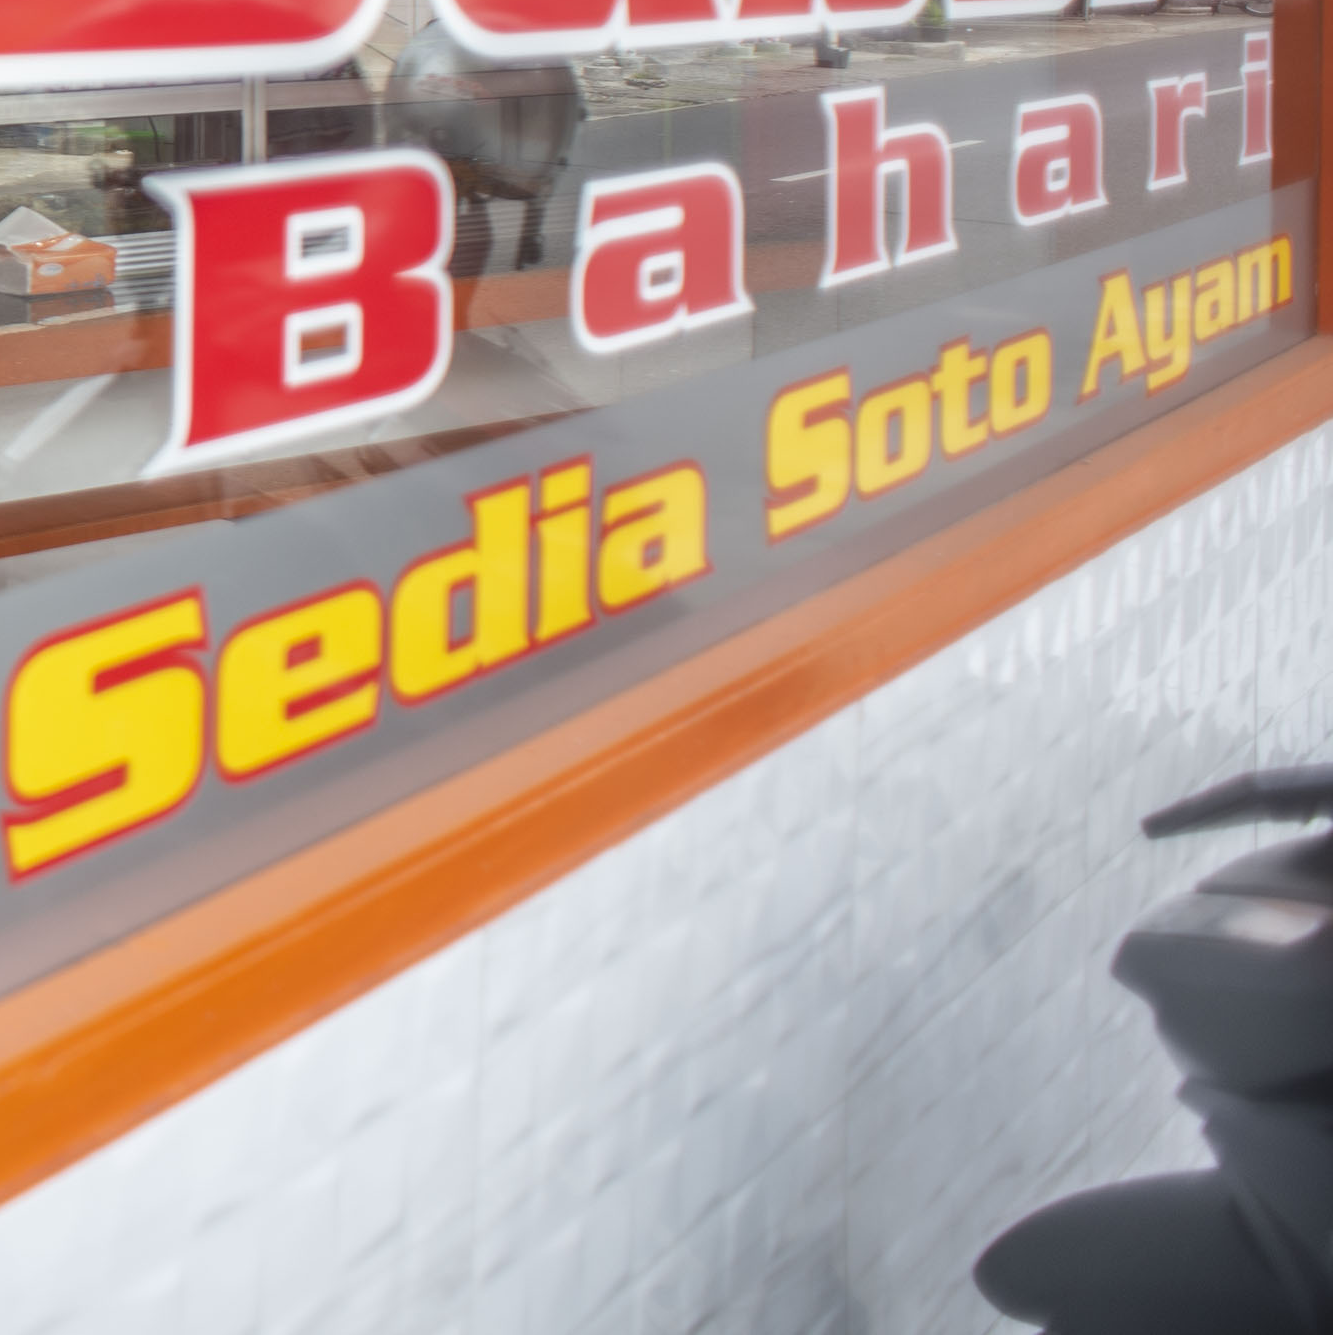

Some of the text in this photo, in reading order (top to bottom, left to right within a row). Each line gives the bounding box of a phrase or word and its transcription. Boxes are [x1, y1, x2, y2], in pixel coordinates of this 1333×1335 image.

[0, 230, 1295, 885] Sedia Soto Ayam
